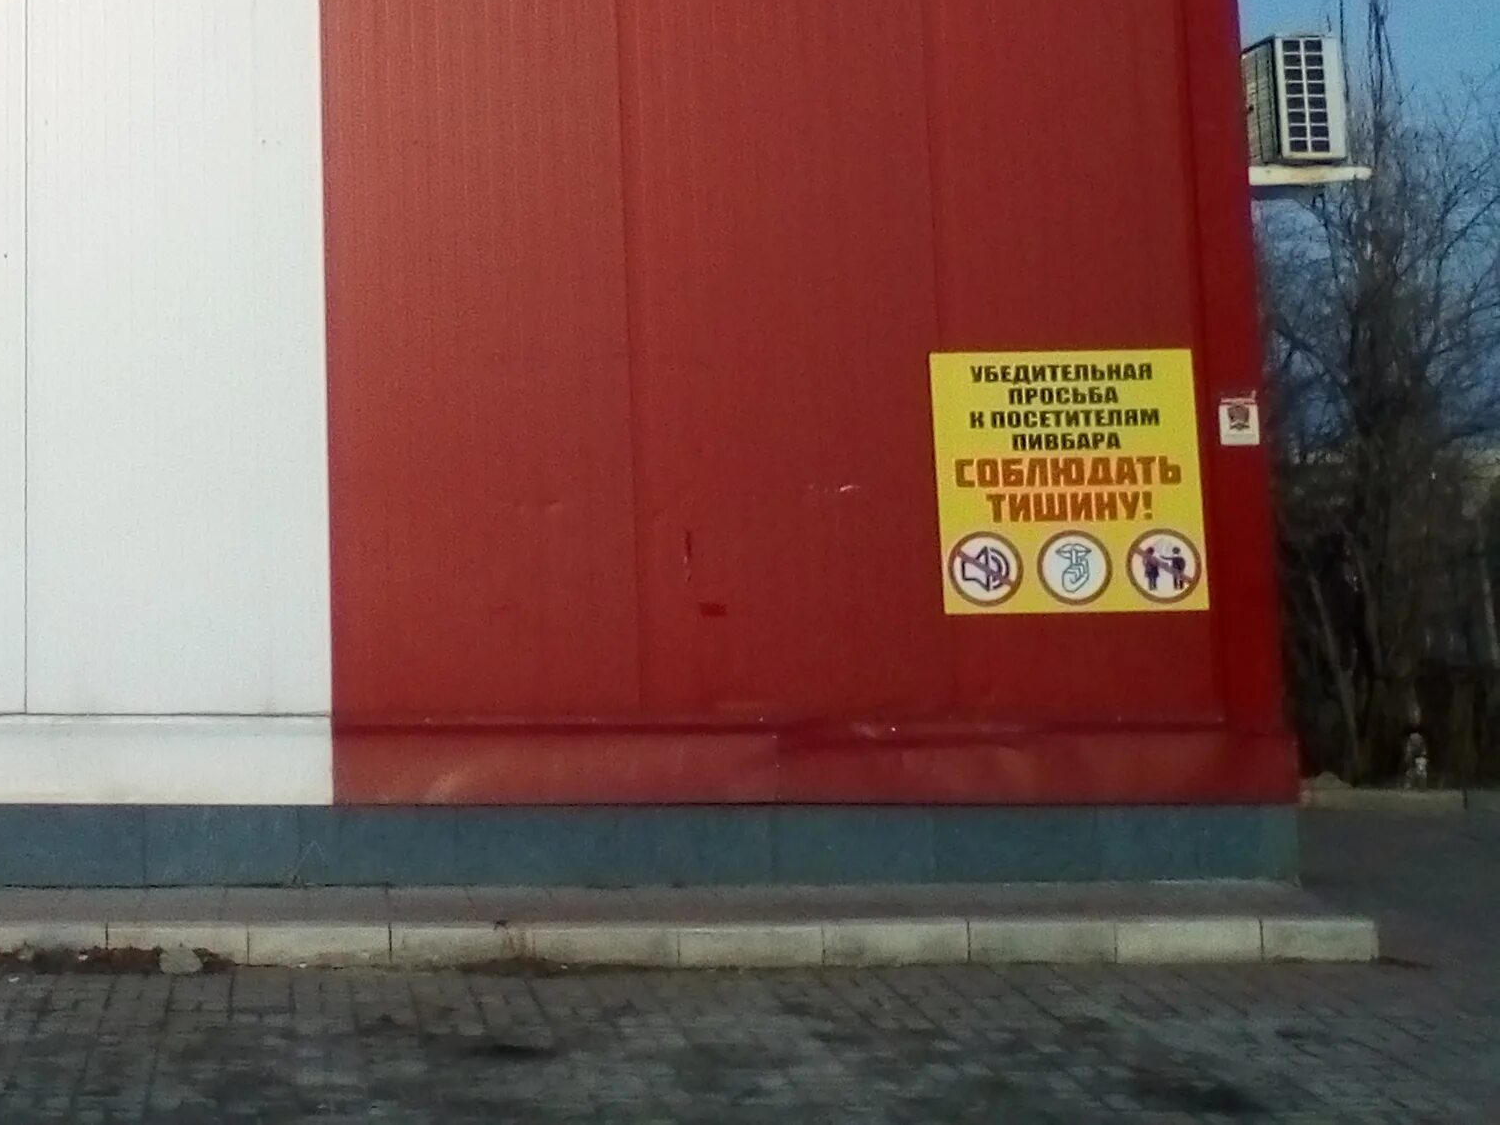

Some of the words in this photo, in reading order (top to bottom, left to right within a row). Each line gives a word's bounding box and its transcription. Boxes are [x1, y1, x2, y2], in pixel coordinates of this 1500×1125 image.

[970, 362, 1153, 384] УБЕДИТЕЛЬНАЯ
[1008, 386, 1118, 405] ПРОСЬБА
[969, 411, 984, 429] К
[990, 408, 1160, 429] ПОСЕТИТЕЛЯМ
[1012, 432, 1121, 451] ПИВБАРА
[954, 455, 1182, 488] СОБЛЮДАТЬ
[986, 491, 1153, 523] ТИШИНУ!
